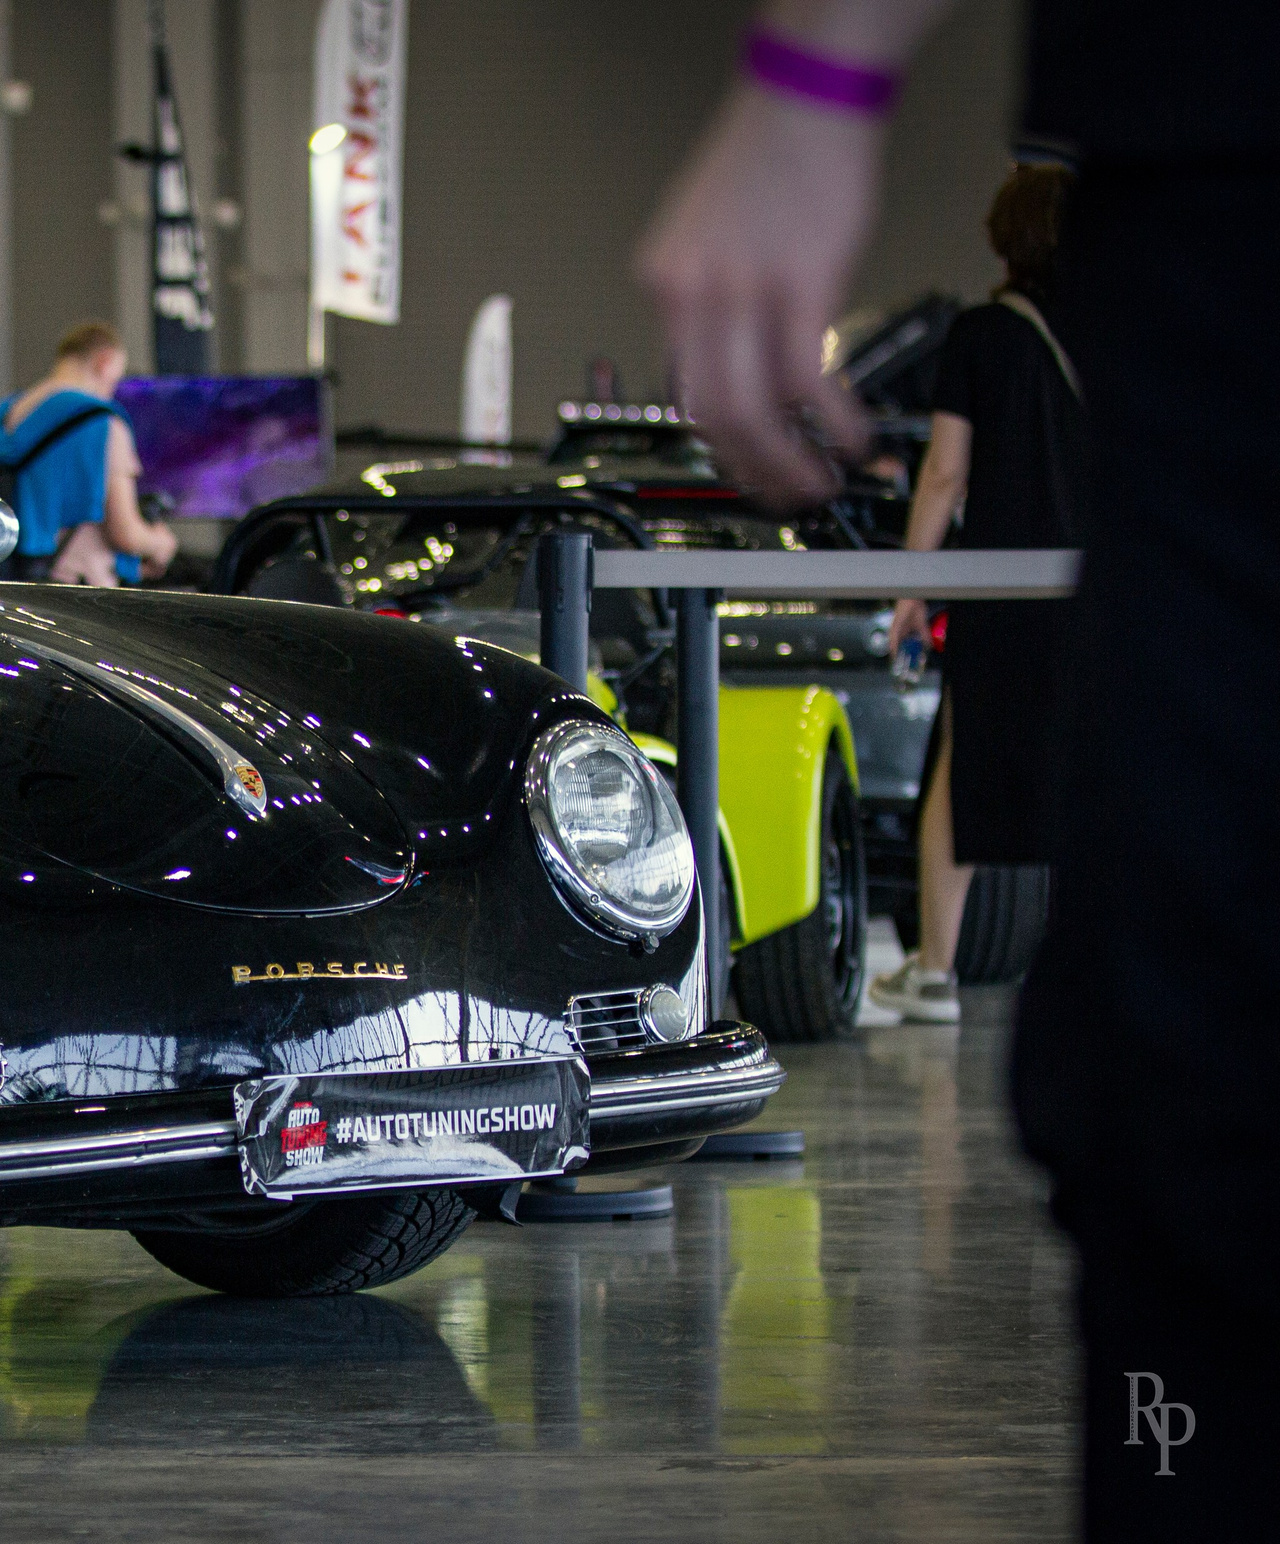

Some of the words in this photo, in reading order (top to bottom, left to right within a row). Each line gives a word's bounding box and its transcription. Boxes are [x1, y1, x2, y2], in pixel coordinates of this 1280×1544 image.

[232, 962, 407, 985] PORSCHE
[288, 1108, 320, 1128] AUTO
[336, 1104, 556, 1143] #AUTOTUNINGSHOW
[286, 1146, 324, 1167] SHOW
